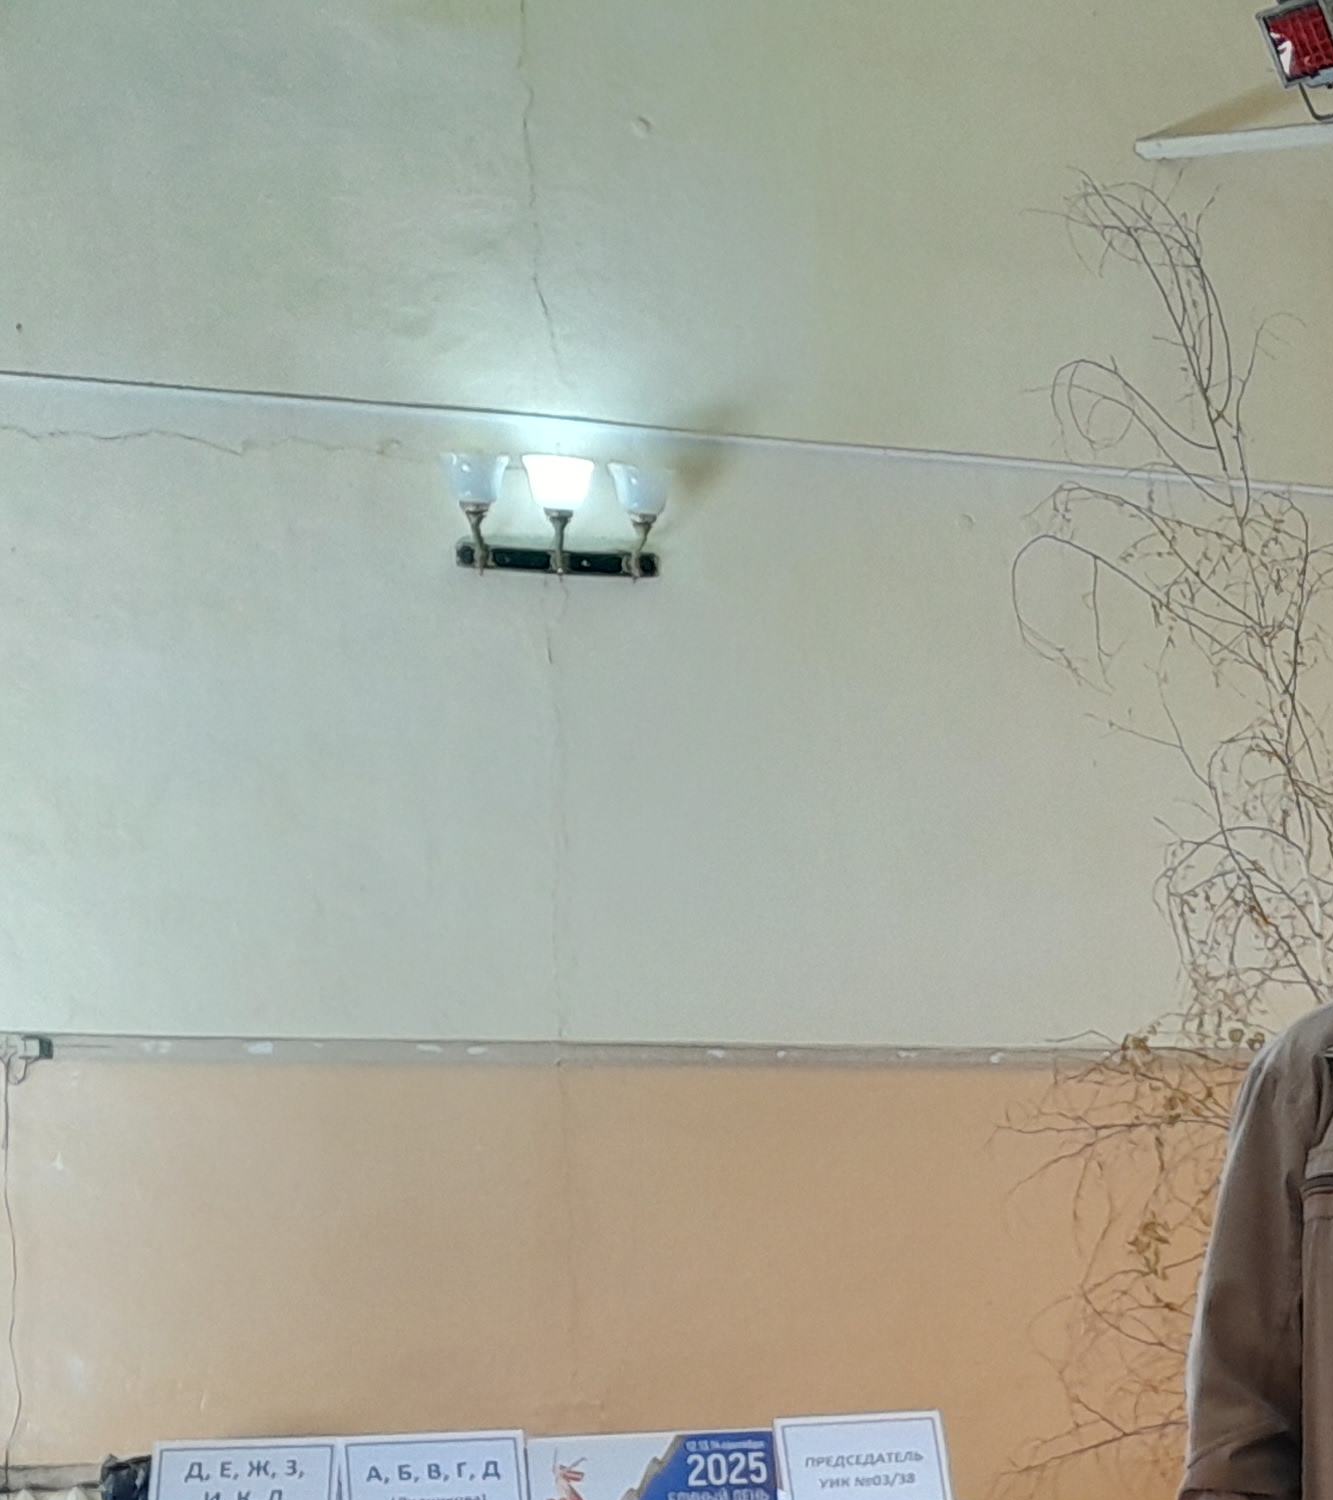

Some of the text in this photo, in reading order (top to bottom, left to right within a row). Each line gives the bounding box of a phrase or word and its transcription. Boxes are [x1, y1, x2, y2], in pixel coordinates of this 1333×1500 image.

[184, 1459, 305, 1483] Д, Е, Ж, З,
[686, 1452, 768, 1487] 2025
[805, 1451, 924, 1468] ПРЕДСЕДАТЕЛЬ
[366, 1460, 501, 1485] А, Б, В, Г, Д
